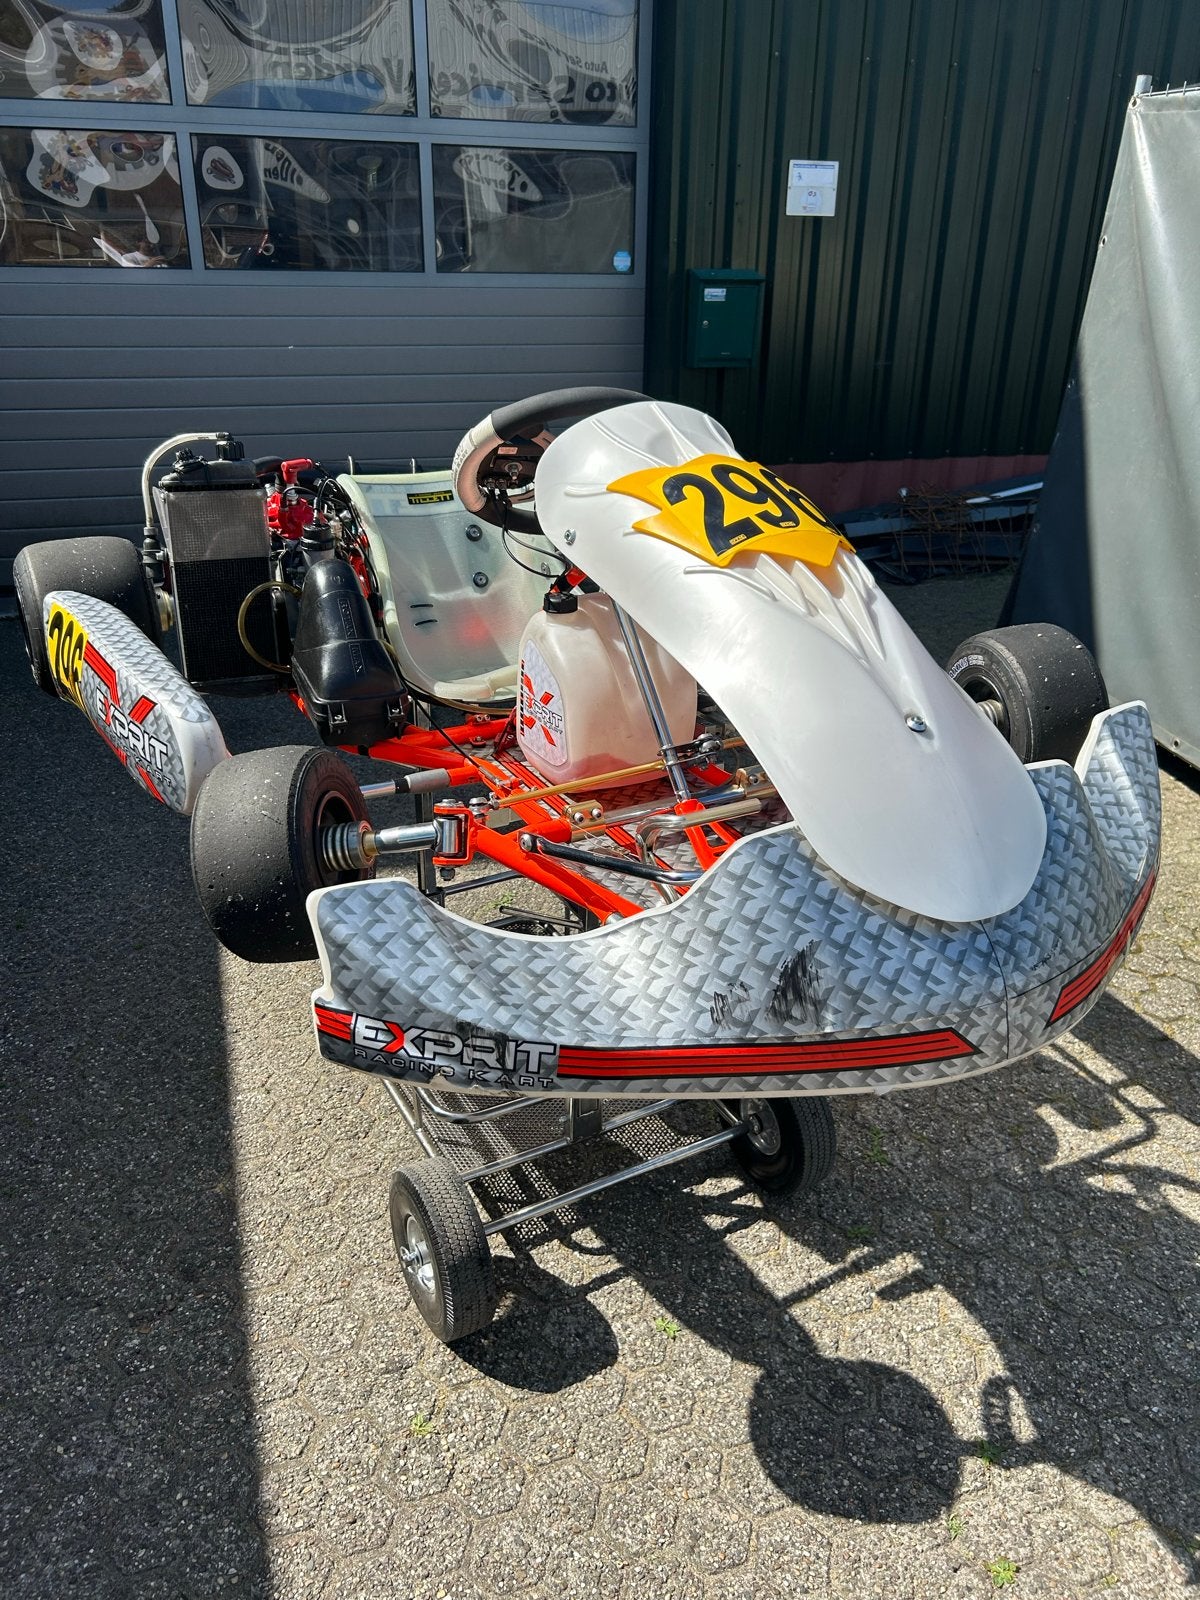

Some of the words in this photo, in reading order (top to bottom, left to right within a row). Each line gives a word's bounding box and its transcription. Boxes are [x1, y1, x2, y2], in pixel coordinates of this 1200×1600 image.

[96, 687, 168, 772] EXPRIT
[353, 1013, 558, 1075] EXPRIT
[353, 1047, 455, 1077] RACING
[468, 1069, 554, 1088] KART
